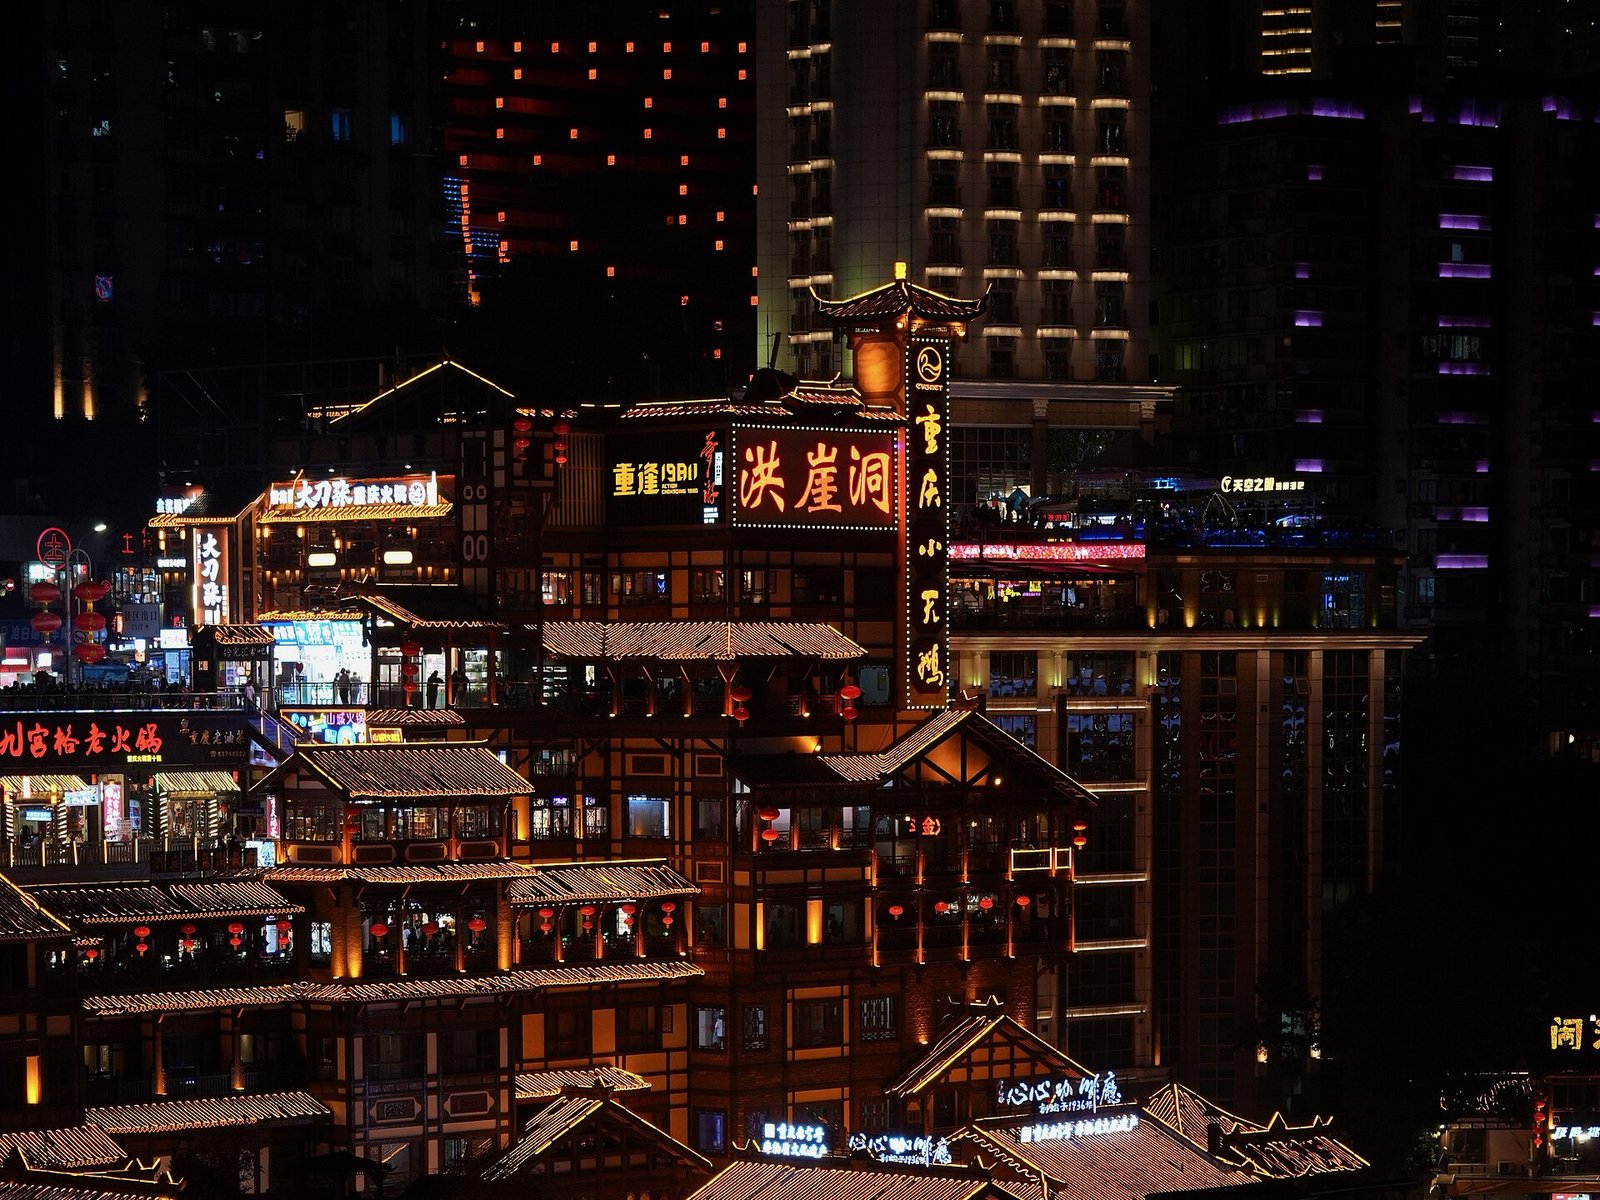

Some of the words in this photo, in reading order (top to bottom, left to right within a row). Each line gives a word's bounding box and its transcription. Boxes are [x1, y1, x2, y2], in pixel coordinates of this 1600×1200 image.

[741, 440, 890, 514] 洪崖洞
[915, 404, 944, 687] 重庆小天鹅
[0, 720, 163, 758] 九宫格老火锅
